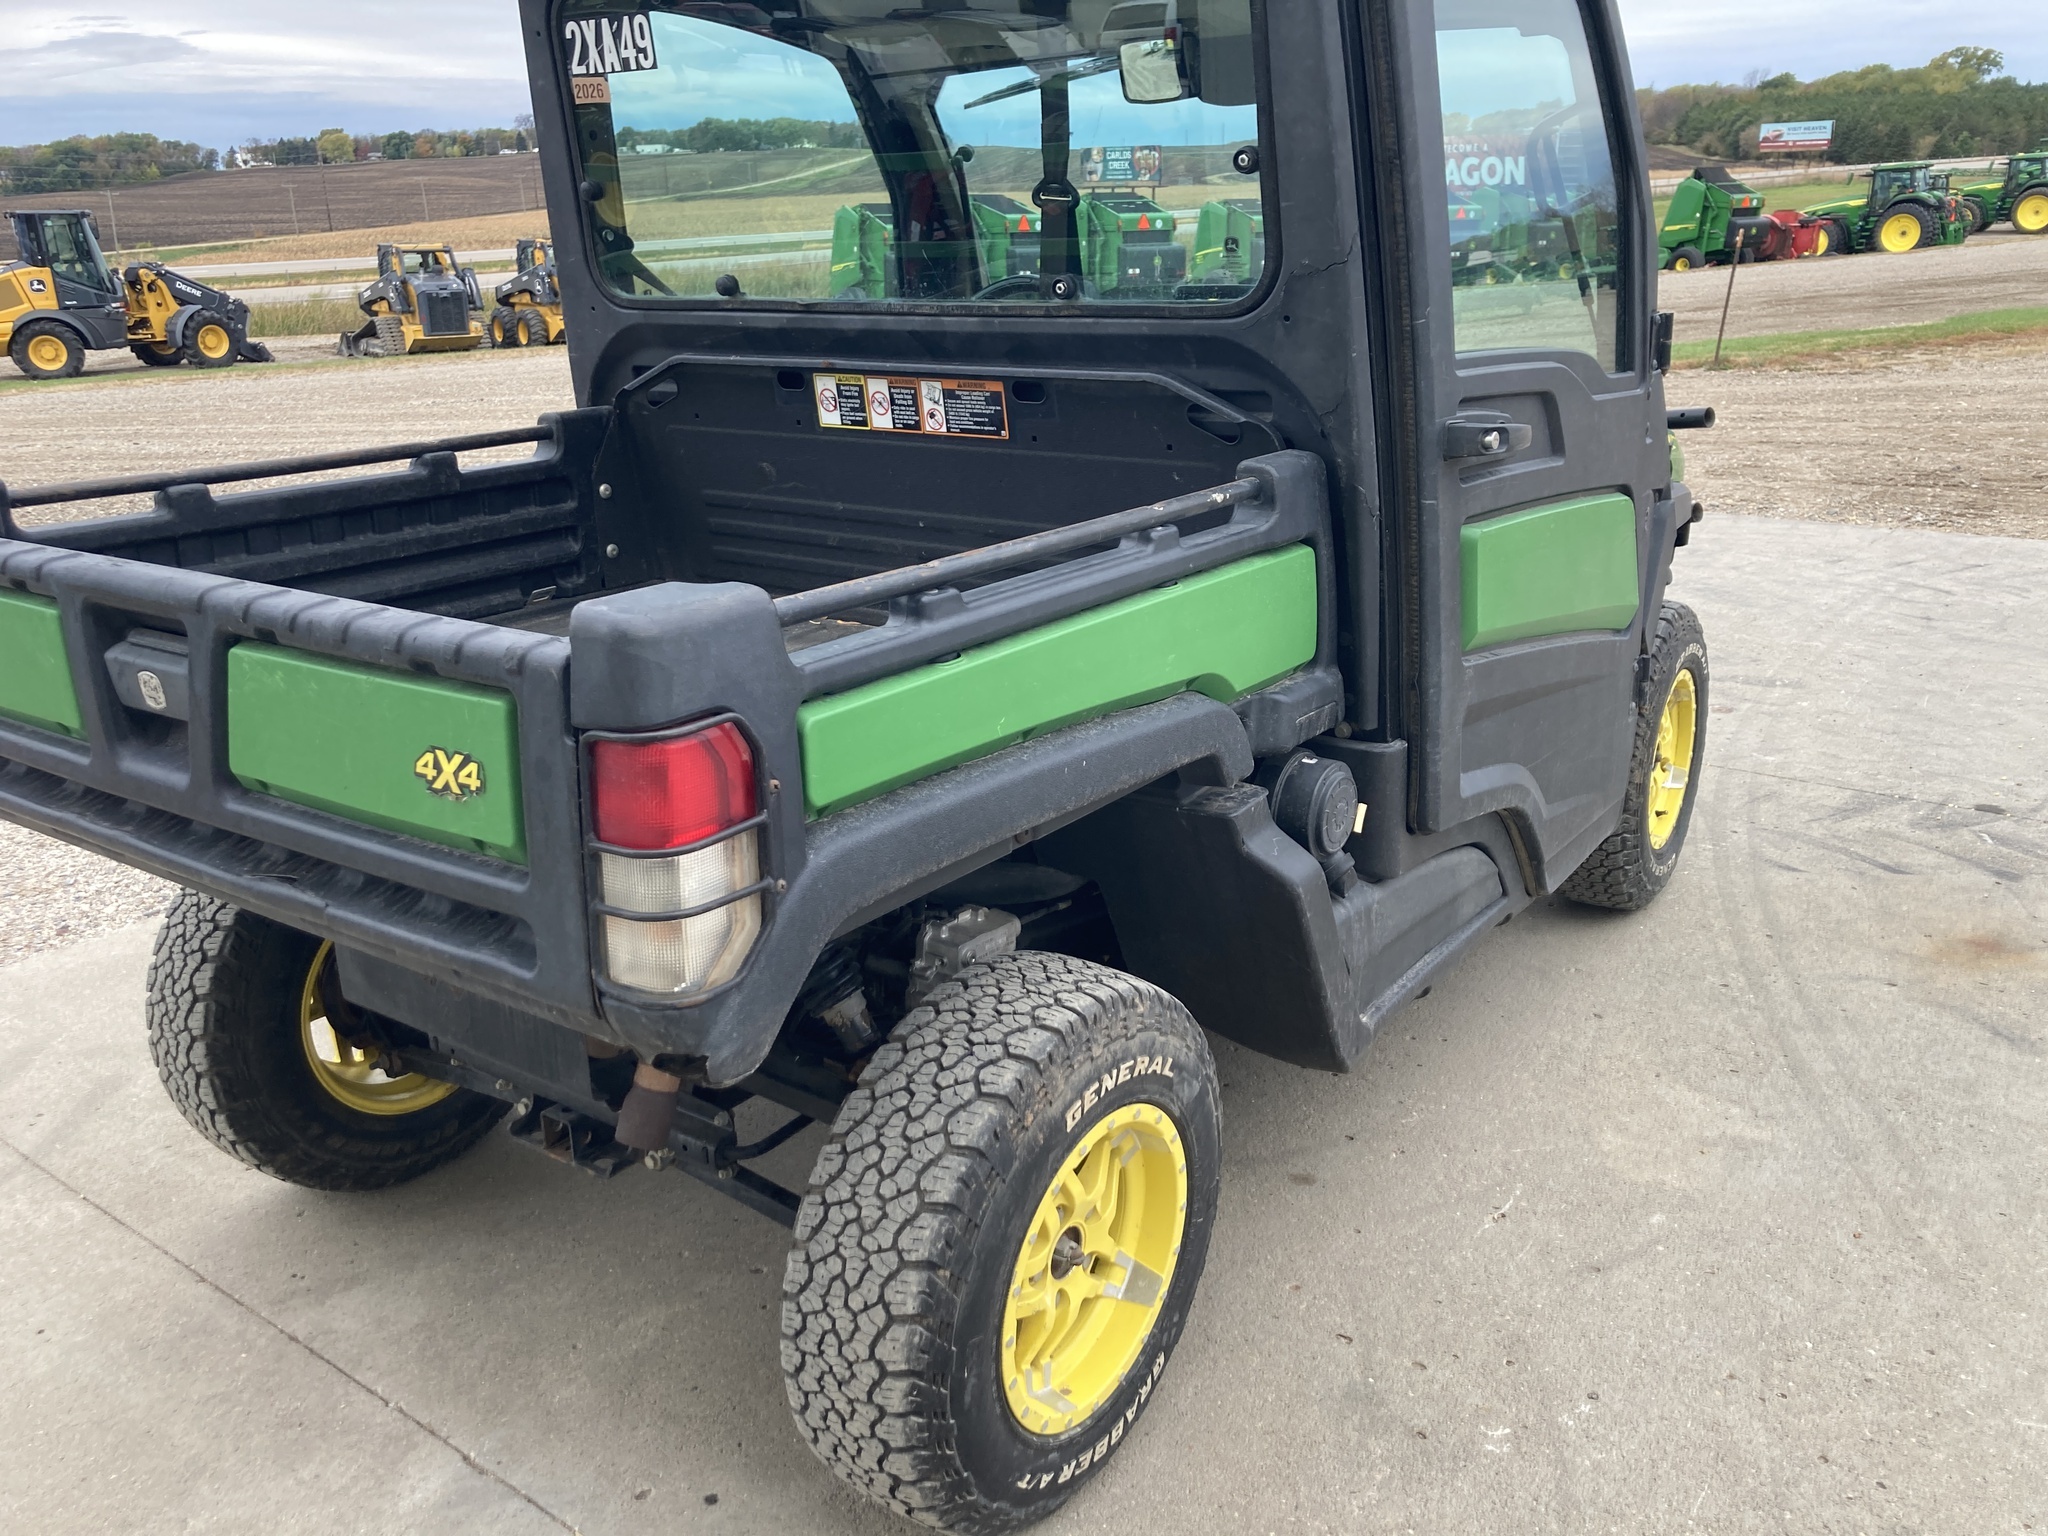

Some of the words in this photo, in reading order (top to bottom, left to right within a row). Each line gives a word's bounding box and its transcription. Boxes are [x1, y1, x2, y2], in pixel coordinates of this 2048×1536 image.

[565, 14, 655, 75] 2XA49
[574, 83, 604, 99] 2026
[1108, 160, 1130, 169] CREEK
[175, 281, 202, 297] DEERE
[415, 749, 481, 795] 4X4
[1065, 1055, 1175, 1133] GENERAL
[1057, 1351, 1165, 1484] GRABBER
[1017, 1472, 1055, 1490] A/T
